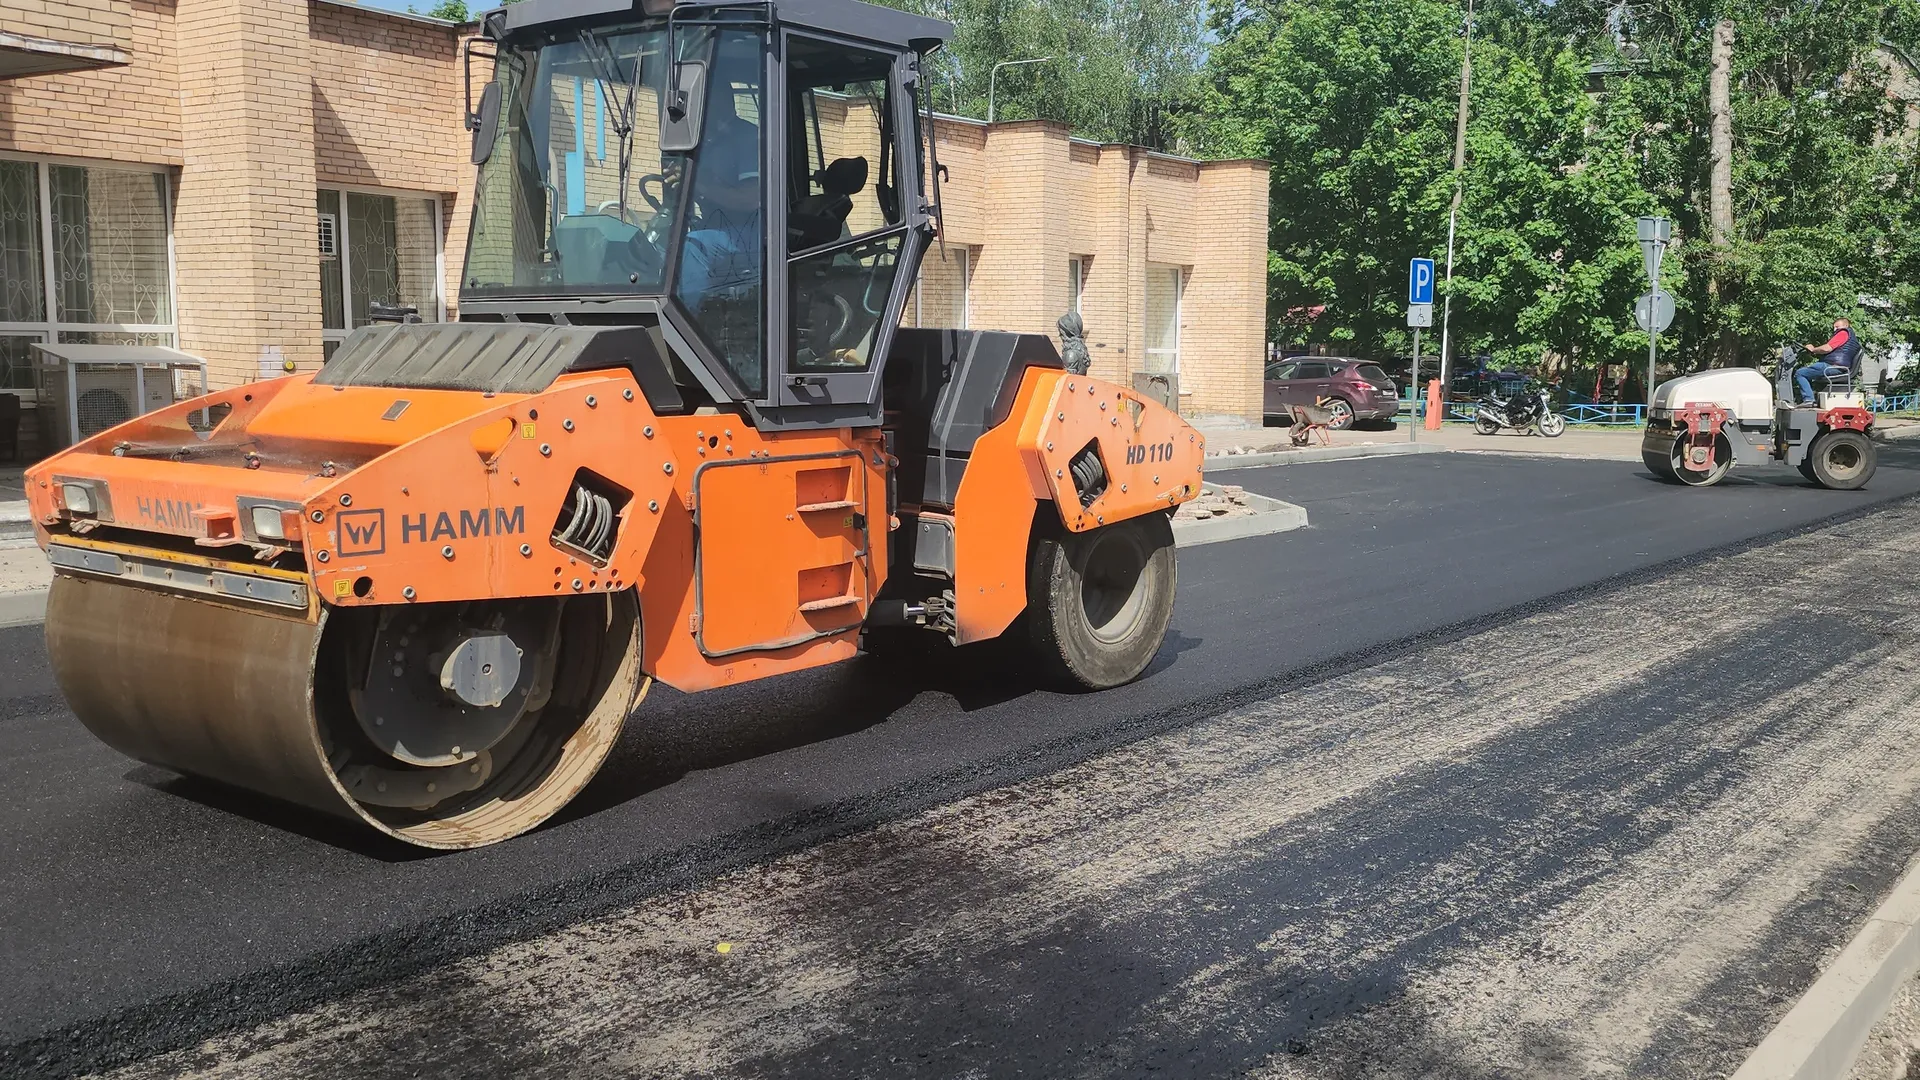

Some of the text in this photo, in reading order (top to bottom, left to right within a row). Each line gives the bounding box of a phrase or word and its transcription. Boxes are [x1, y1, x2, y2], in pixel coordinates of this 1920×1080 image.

[1416, 263, 1430, 299] P
[1126, 442, 1173, 465] HD 110
[401, 505, 525, 544] HAMM
